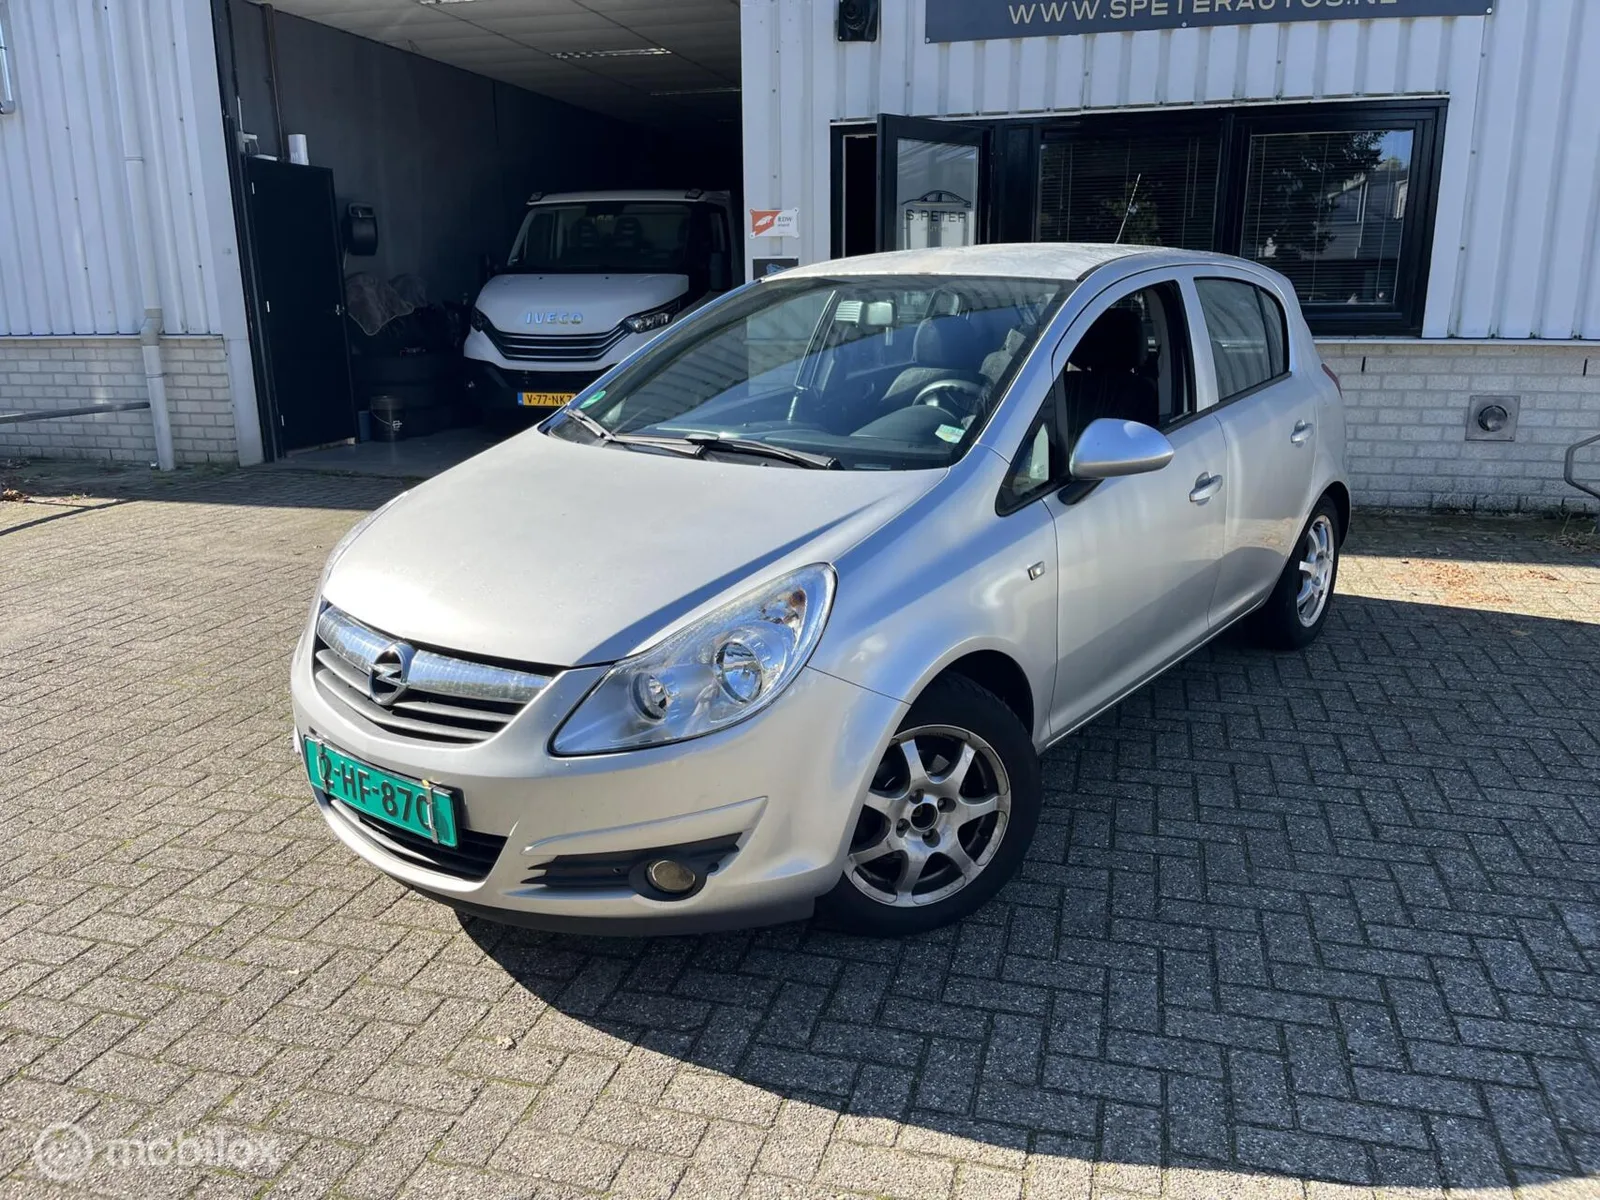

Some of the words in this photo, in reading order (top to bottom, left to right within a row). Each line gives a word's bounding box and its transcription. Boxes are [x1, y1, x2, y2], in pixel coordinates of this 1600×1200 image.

[1008, 0, 1397, 25] WWW.SPETERA.
[905, 209, 967, 223] S.PETER
[526, 312, 583, 324] IVECO
